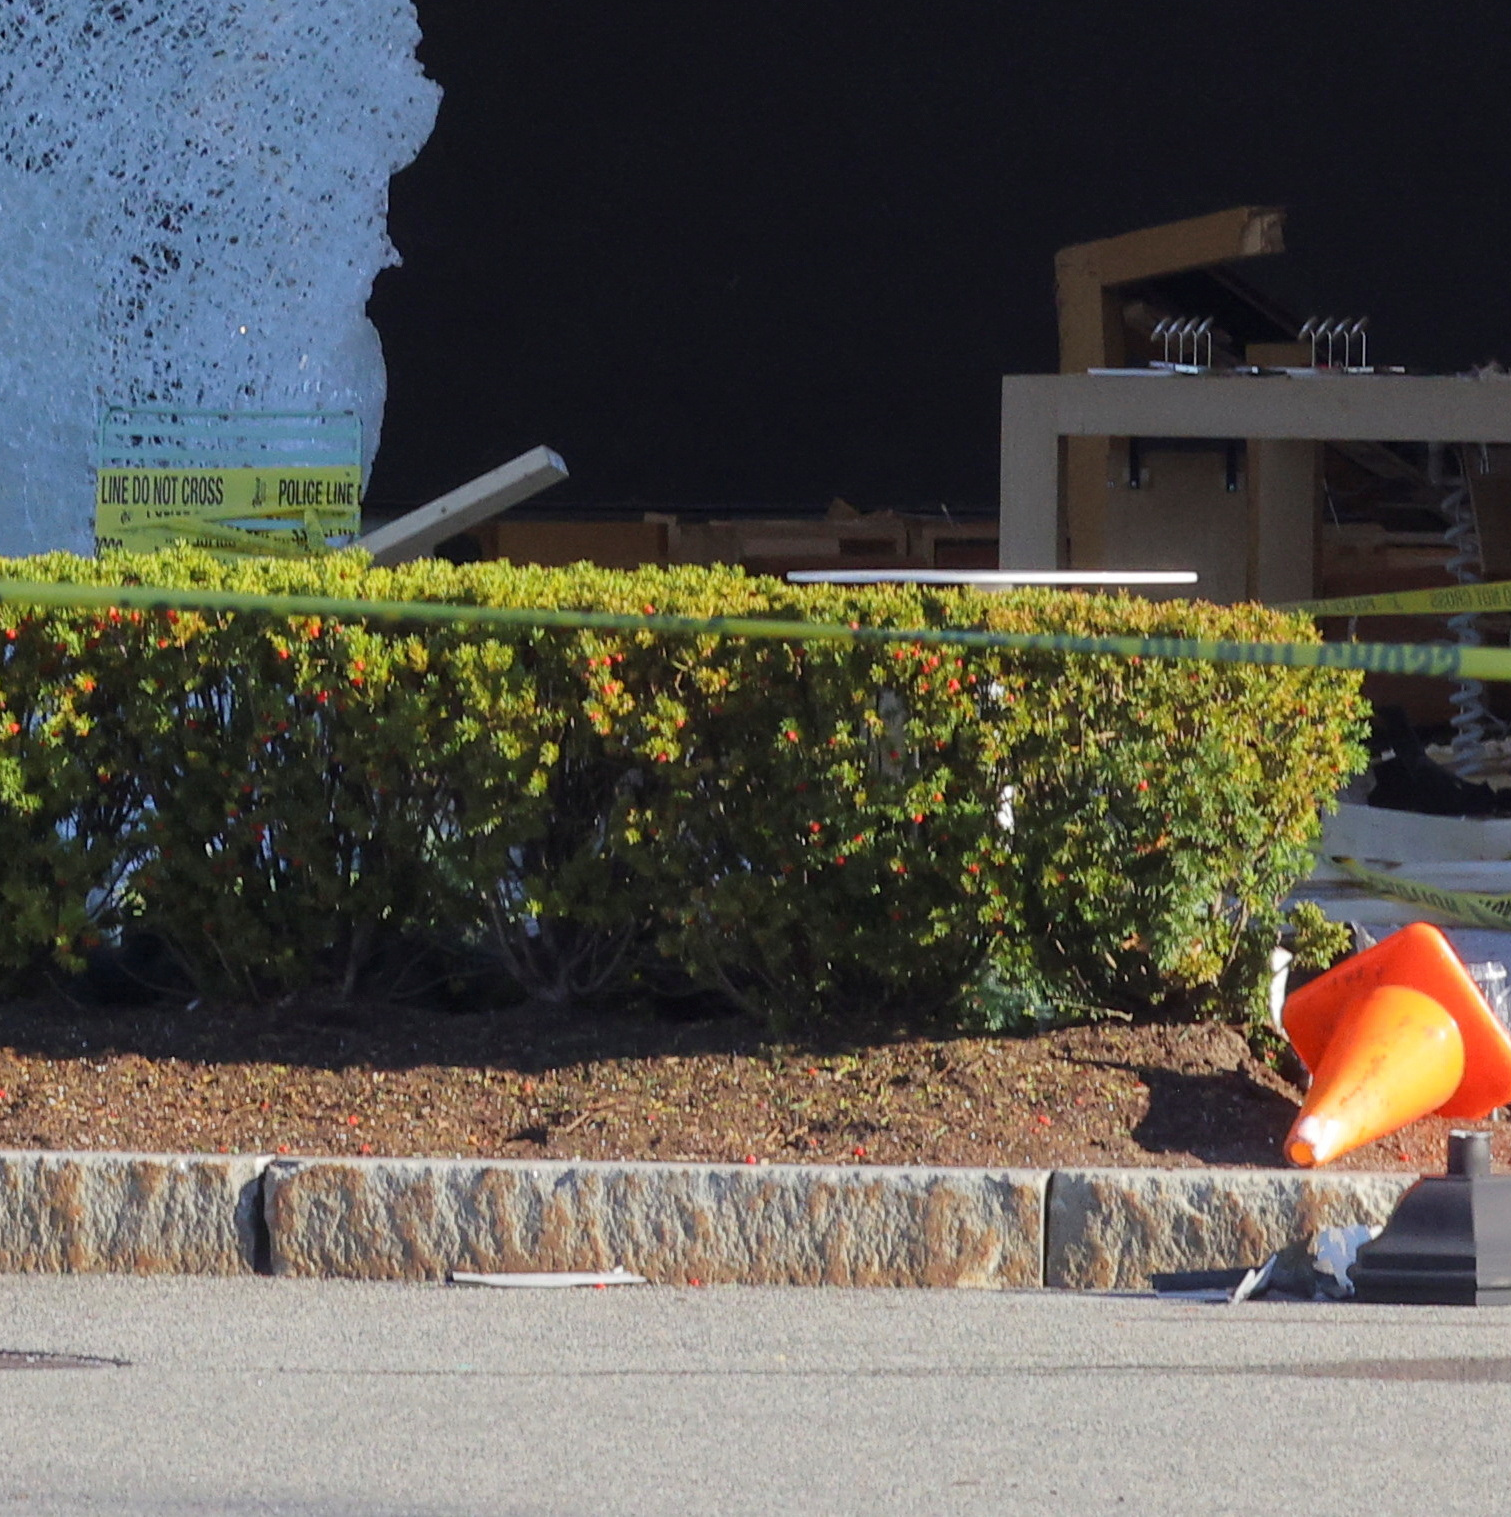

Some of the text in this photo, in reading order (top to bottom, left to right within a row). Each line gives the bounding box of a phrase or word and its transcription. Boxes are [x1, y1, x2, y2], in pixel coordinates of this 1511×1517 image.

[102, 476, 224, 506] LINE DO NOT CROSS
[279, 479, 354, 507] POLICE LINE
